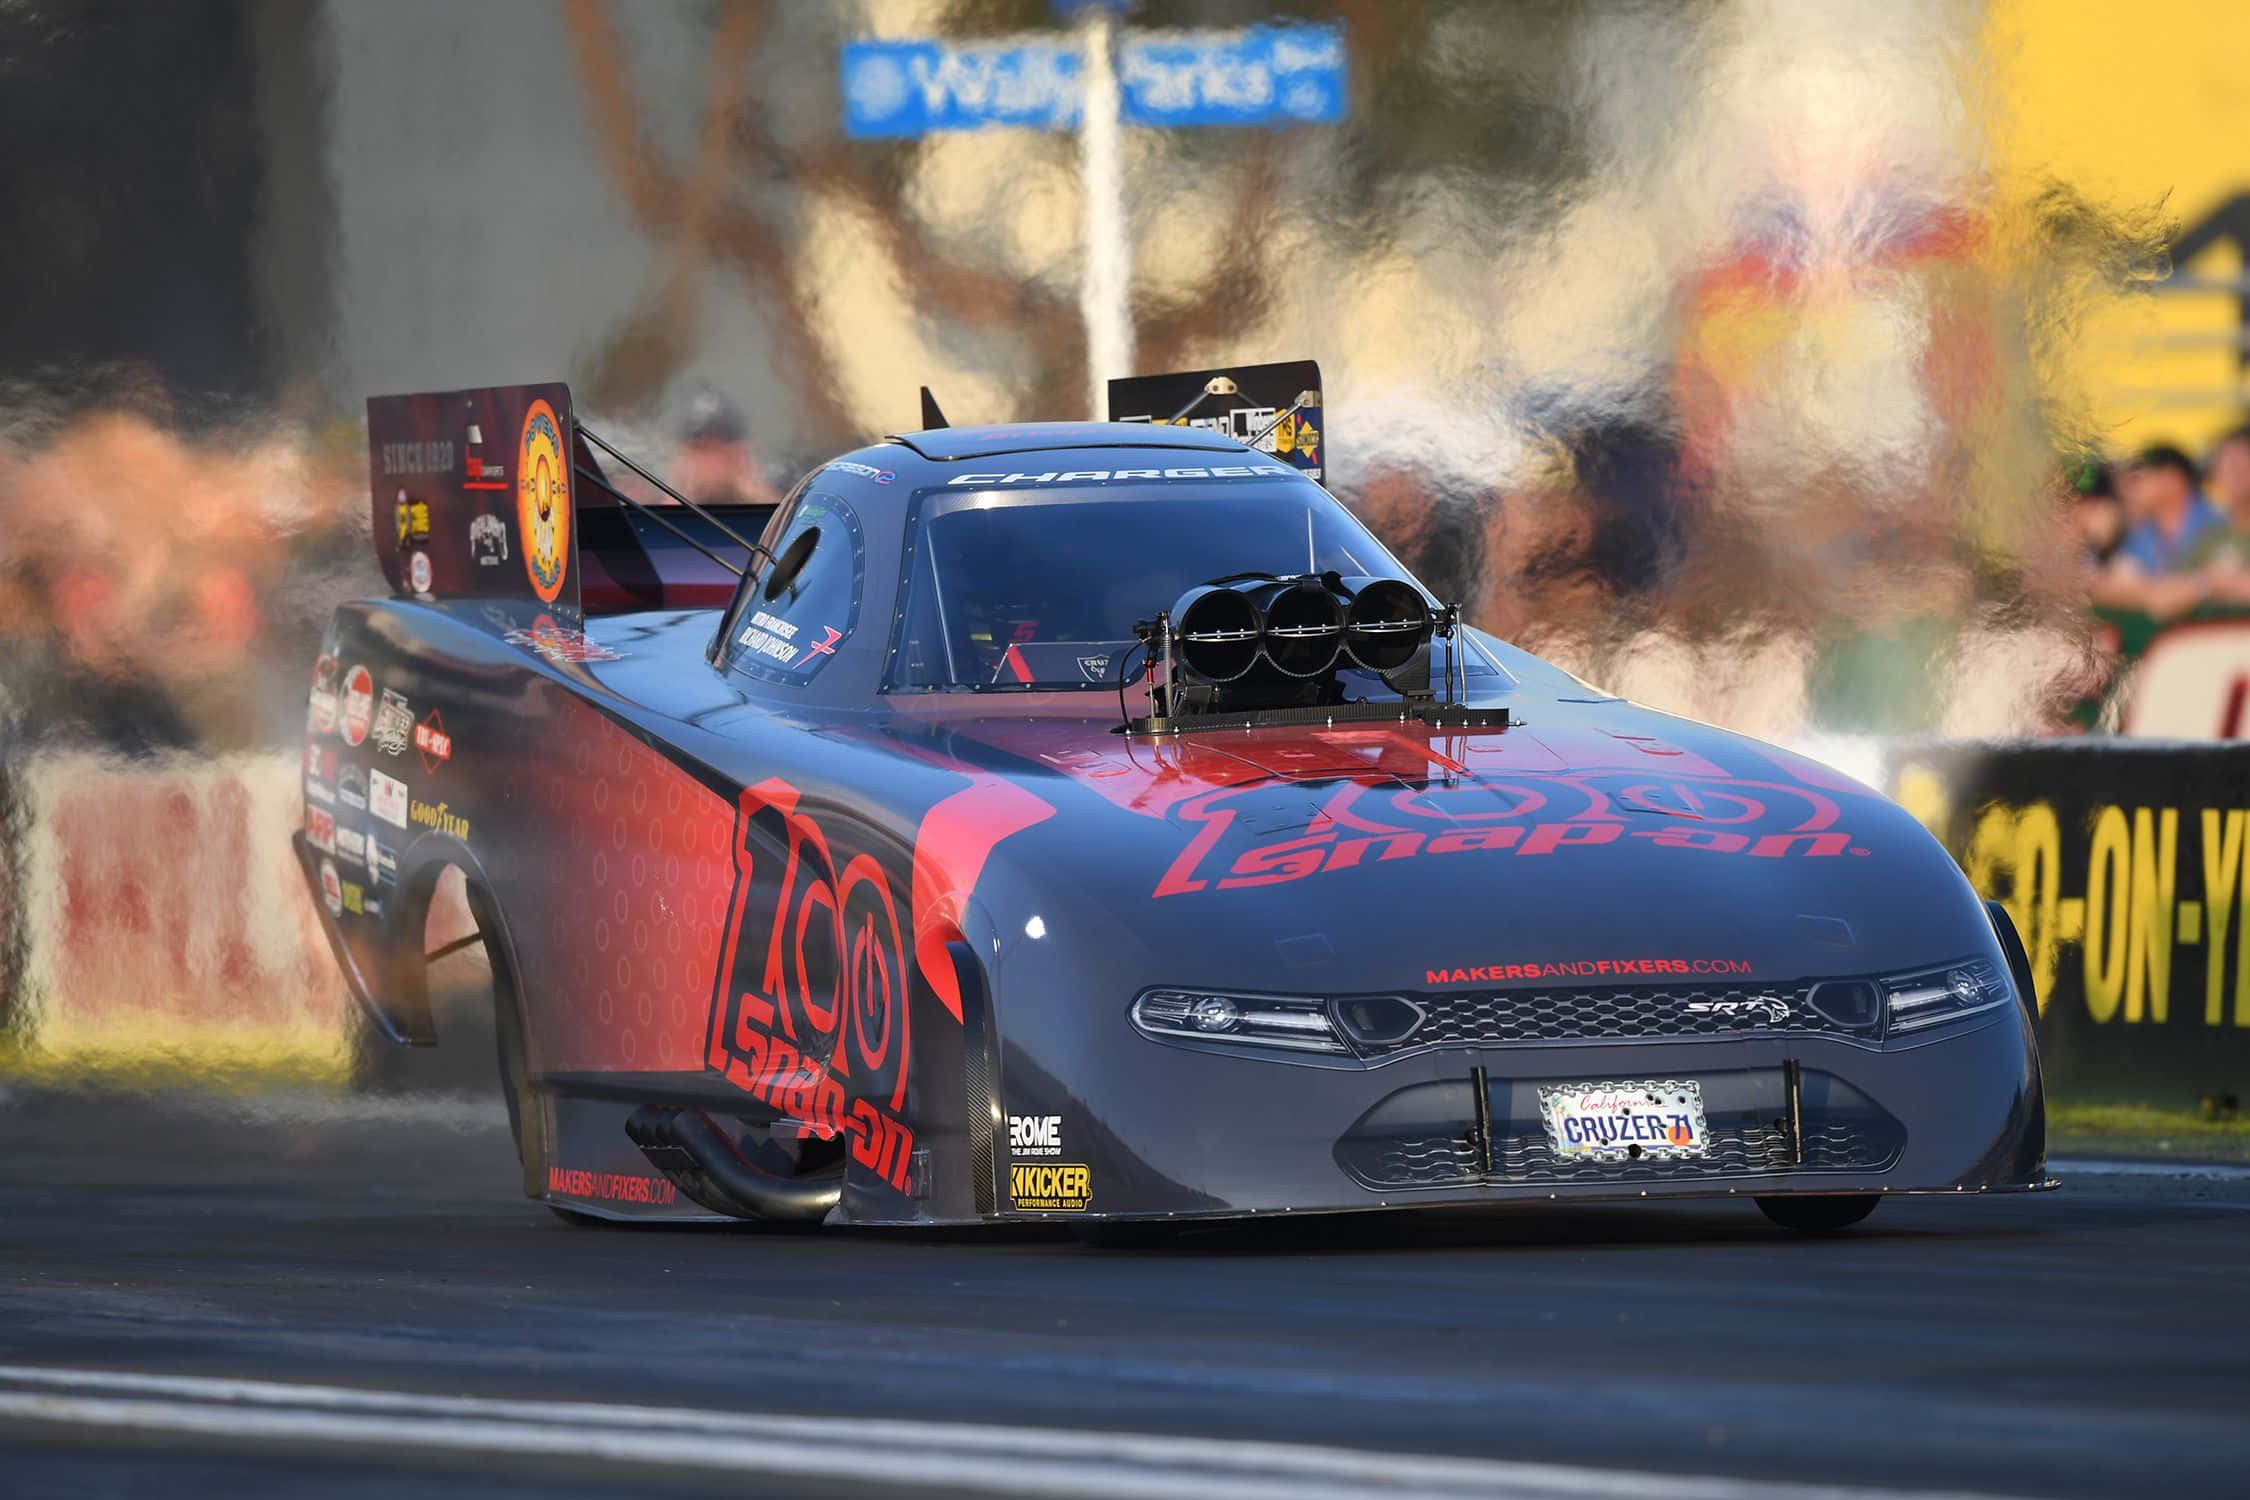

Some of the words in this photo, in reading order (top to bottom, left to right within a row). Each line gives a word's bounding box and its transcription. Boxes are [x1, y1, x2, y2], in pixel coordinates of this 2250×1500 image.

[384, 441, 421, 475] SINCE
[947, 465, 1290, 485] CHARGER
[410, 800, 470, 842] GOODYEAR
[1965, 800, 2250, 1028] O-ON-Y
[1426, 959, 1753, 985] MAKERSANDFIXERS.COM
[1683, 1001, 1765, 1016] SRT
[1009, 1116, 1061, 1146] ROME
[1564, 1114, 1667, 1144] CRUZER
[1666, 1114, 1694, 1141] 71
[549, 1167, 677, 1205] MAKERSANDFIXERS.COM
[1017, 1198, 1061, 1208] PERFORMANCE
[1062, 1198, 1084, 1208] AUDIO
